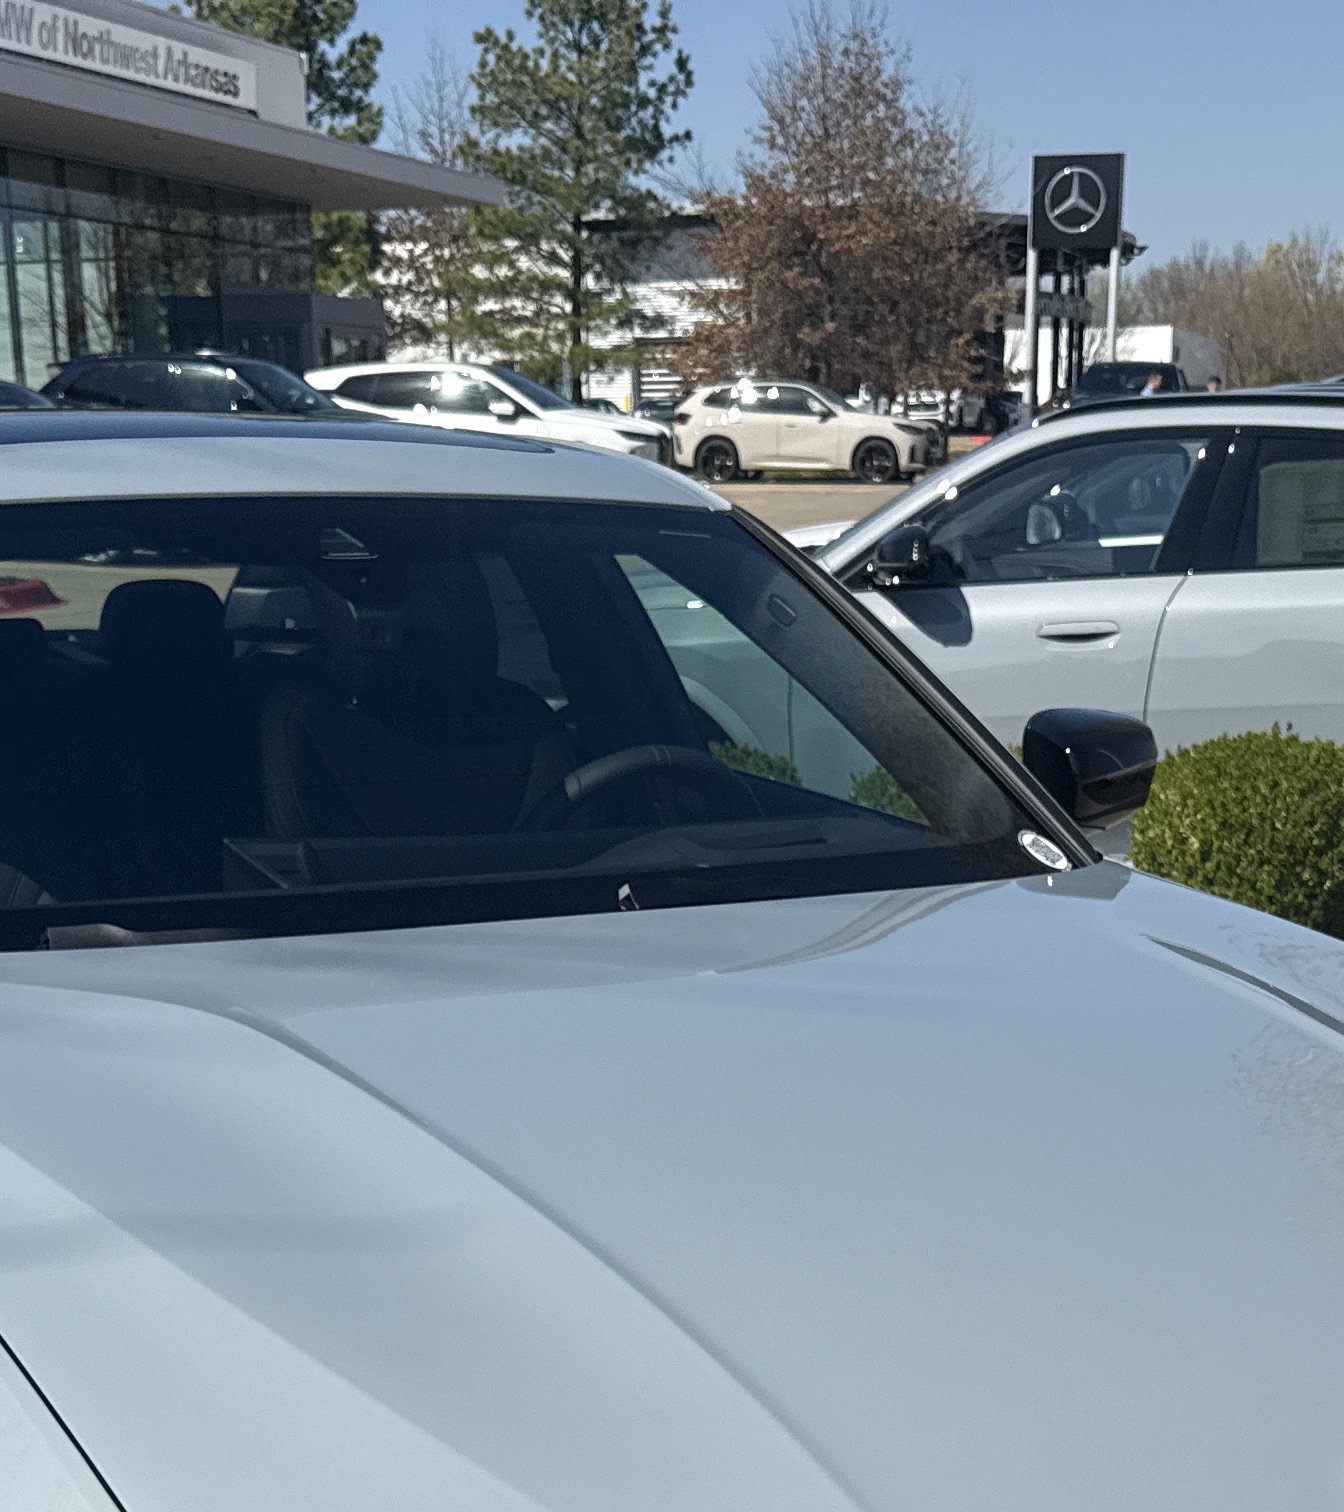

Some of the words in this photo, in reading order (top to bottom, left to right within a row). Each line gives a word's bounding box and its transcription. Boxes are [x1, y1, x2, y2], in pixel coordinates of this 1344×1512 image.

[38, 14, 60, 53] of
[62, 17, 158, 79] Northwest
[163, 46, 240, 98] Arkansas
